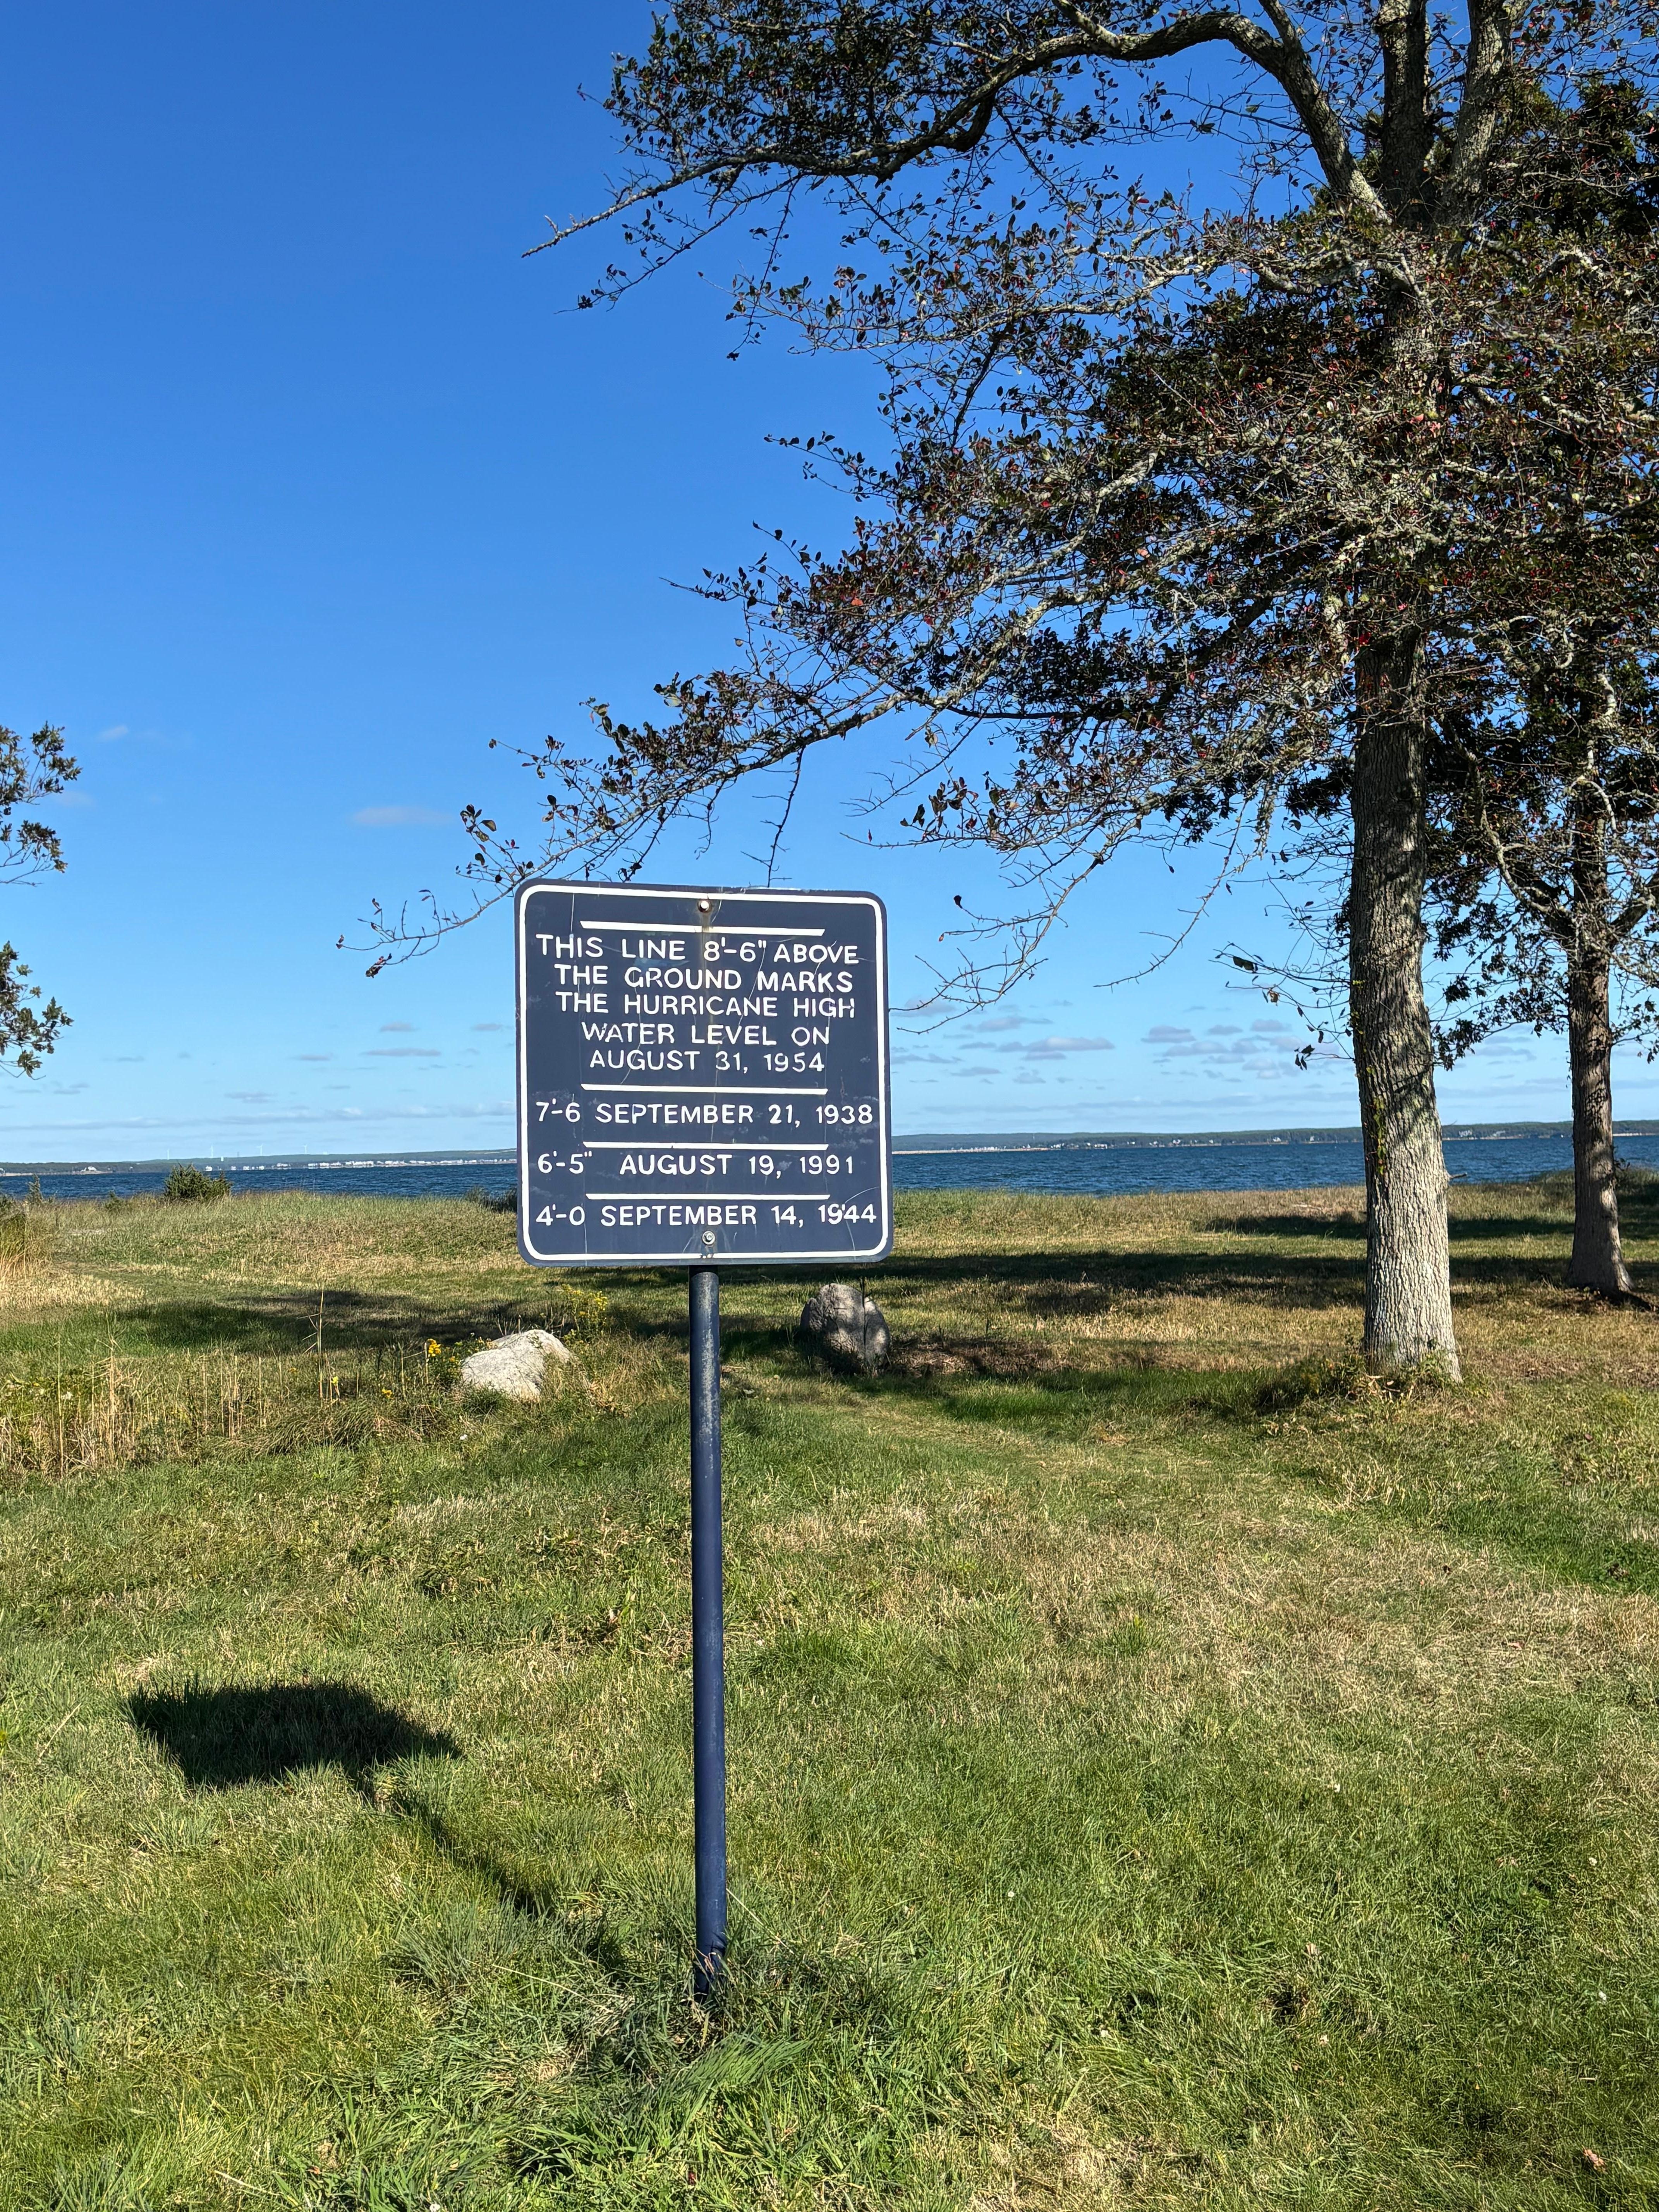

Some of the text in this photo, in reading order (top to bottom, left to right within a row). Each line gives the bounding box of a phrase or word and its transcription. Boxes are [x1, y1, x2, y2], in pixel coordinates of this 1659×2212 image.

[536, 934, 603, 958] THIS
[622, 939, 685, 960] LINE
[773, 944, 859, 965] ABOVE
[554, 964, 853, 993] THE GROUND MARKS
[555, 991, 855, 1018] THE HURRICANE HIGH
[581, 1022, 830, 1046] WATER LEVEL ON
[590, 1049, 824, 1073] AUGUST 31, 1954
[595, 1103, 753, 1124] SEPTEMBER
[768, 1104, 800, 1128] 21,
[816, 1104, 873, 1124] 1938
[620, 1154, 732, 1175] AUGUST
[749, 1155, 781, 1179] 19,
[800, 1154, 852, 1175] 1991
[601, 1205, 756, 1226] SEPTEMBER
[771, 1206, 803, 1228] 14,
